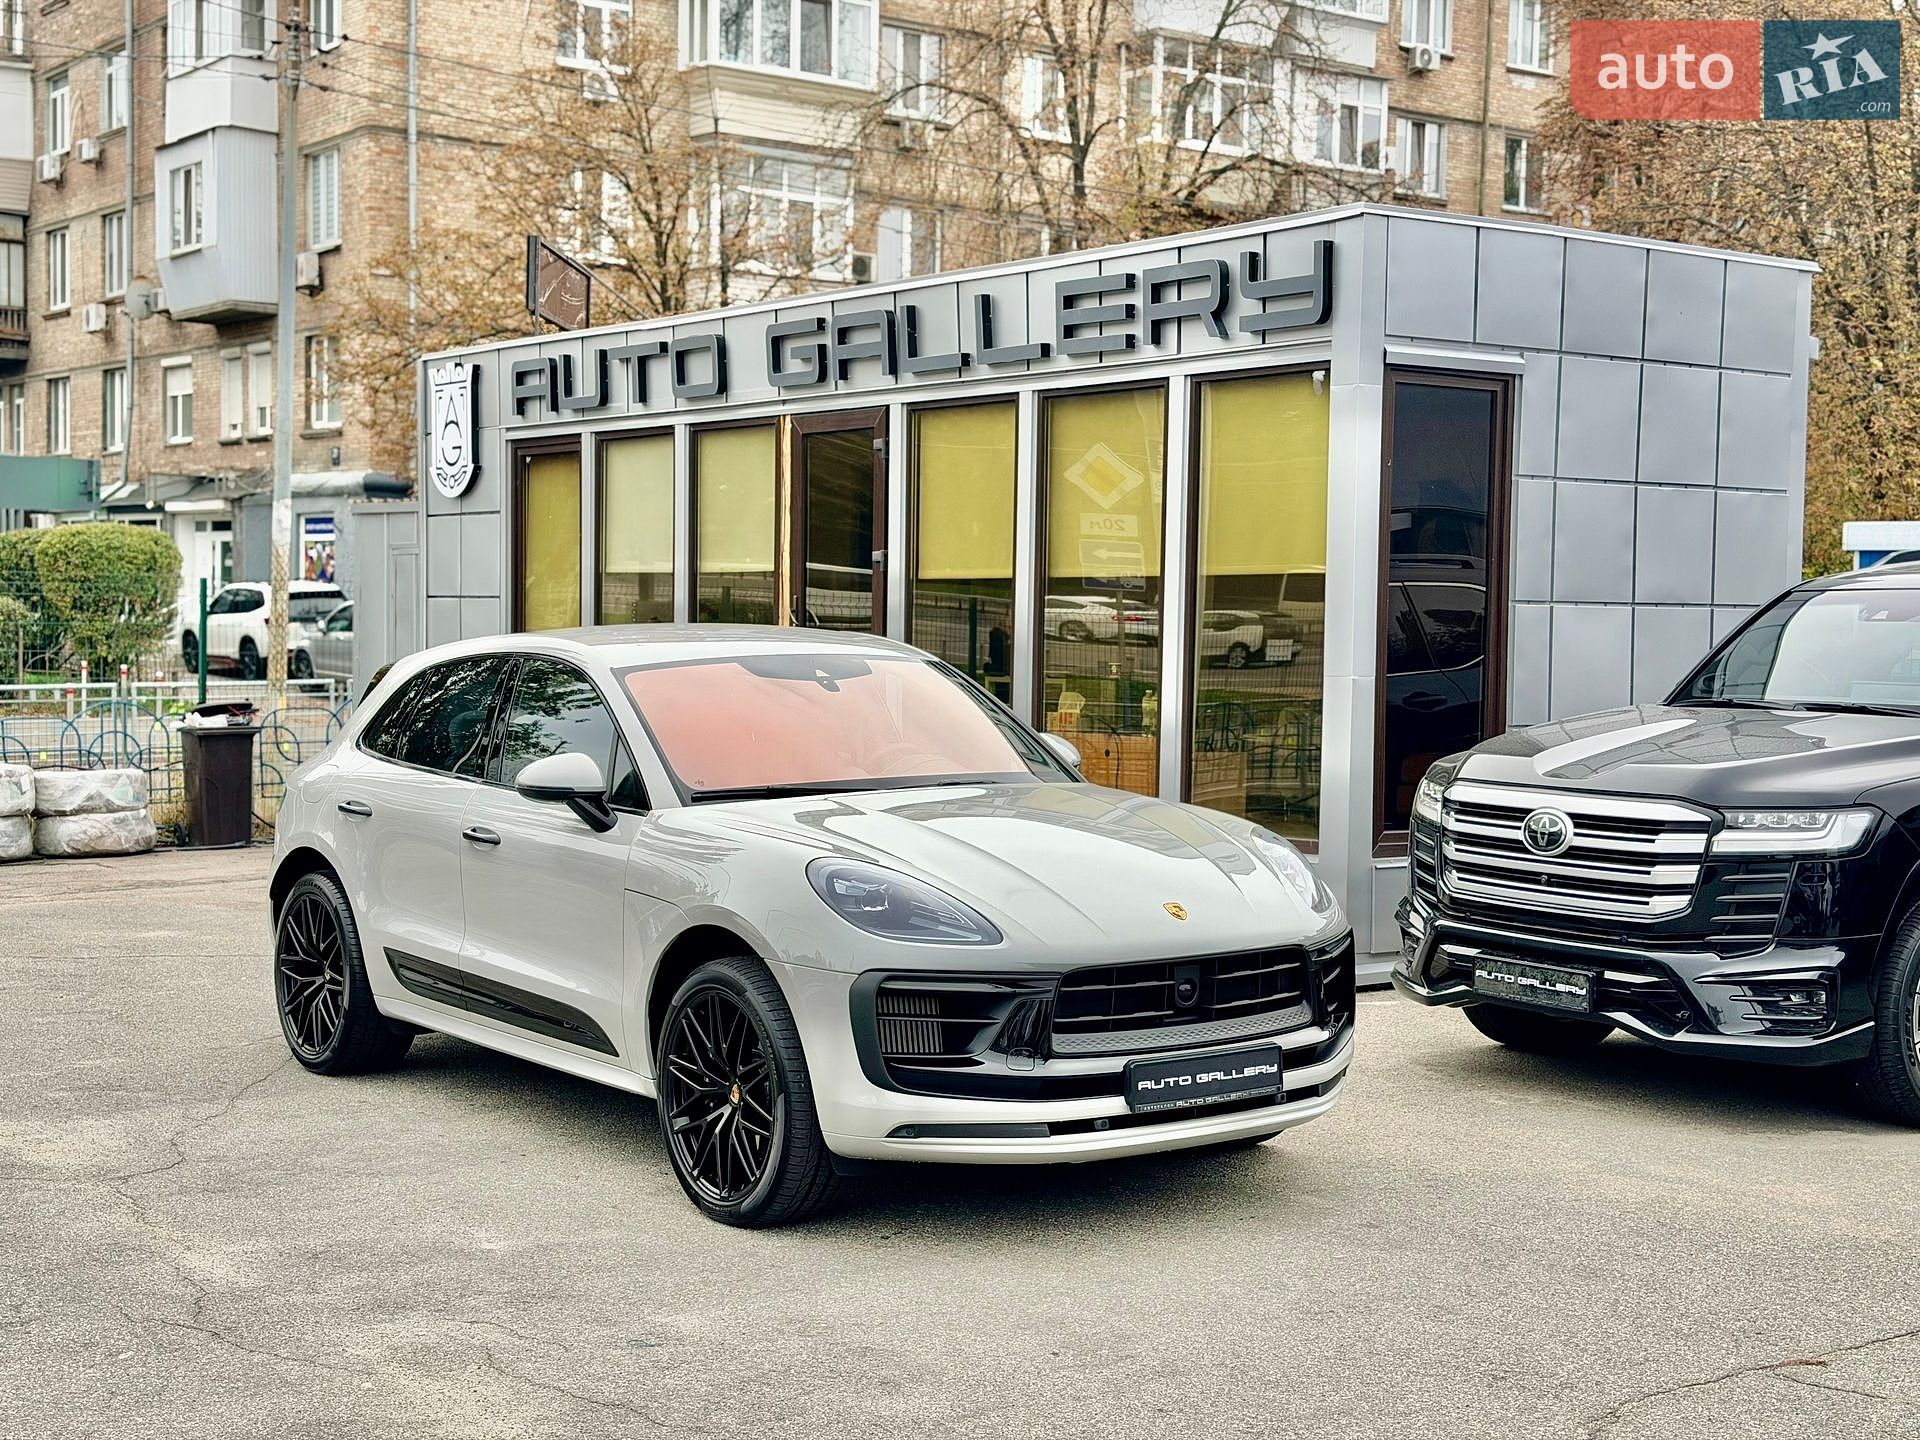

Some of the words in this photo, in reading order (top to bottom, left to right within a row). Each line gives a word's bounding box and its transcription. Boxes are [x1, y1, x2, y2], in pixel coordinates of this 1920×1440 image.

[511, 333, 727, 417] AUTO
[765, 239, 1334, 388] GALLERY
[1475, 969, 1515, 983] AUTO
[1517, 976, 1587, 996] GALLERY
[1137, 1075, 1192, 1091] AUTO
[1196, 1063, 1278, 1084] GALLERY
[1175, 1098, 1205, 1108] AUTO
